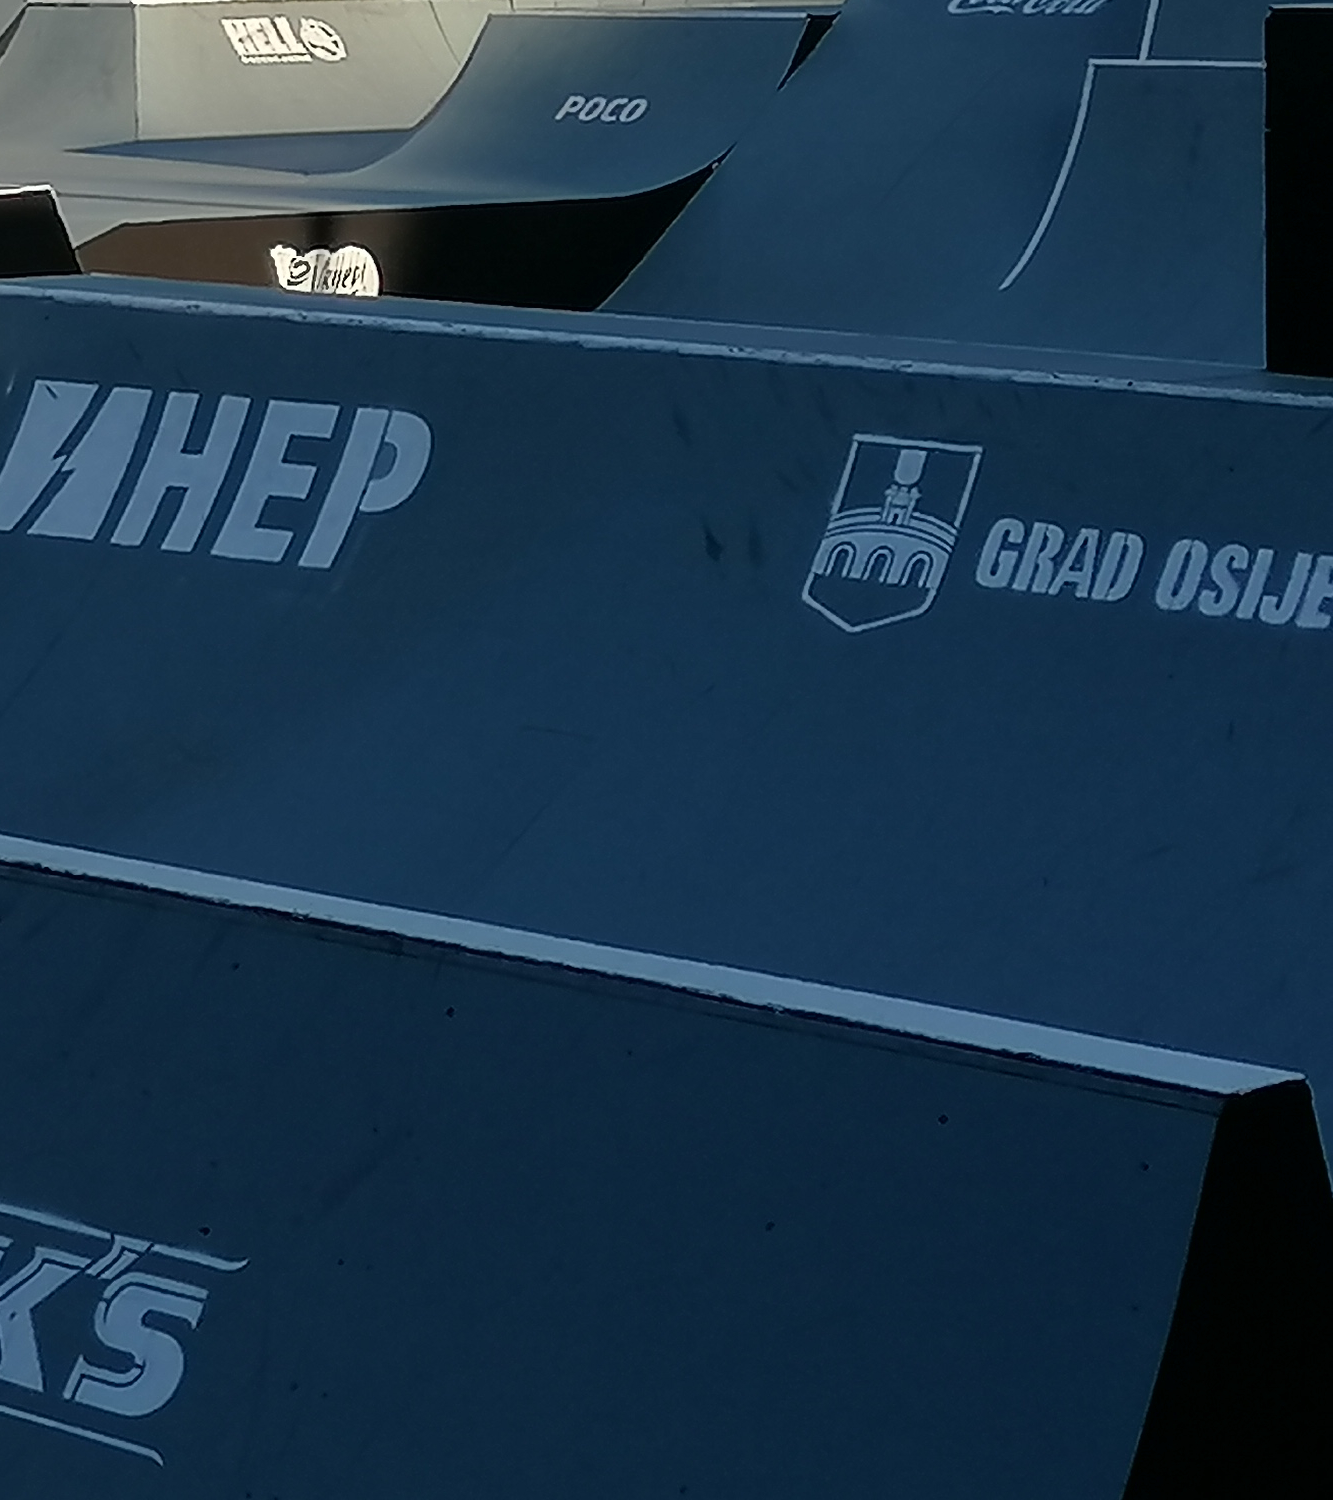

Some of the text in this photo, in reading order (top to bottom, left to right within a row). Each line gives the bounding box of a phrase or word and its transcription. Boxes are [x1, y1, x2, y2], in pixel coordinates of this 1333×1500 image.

[555, 95, 648, 122] POCO
[110, 390, 432, 569] HEP
[976, 517, 1145, 601] GRAD
